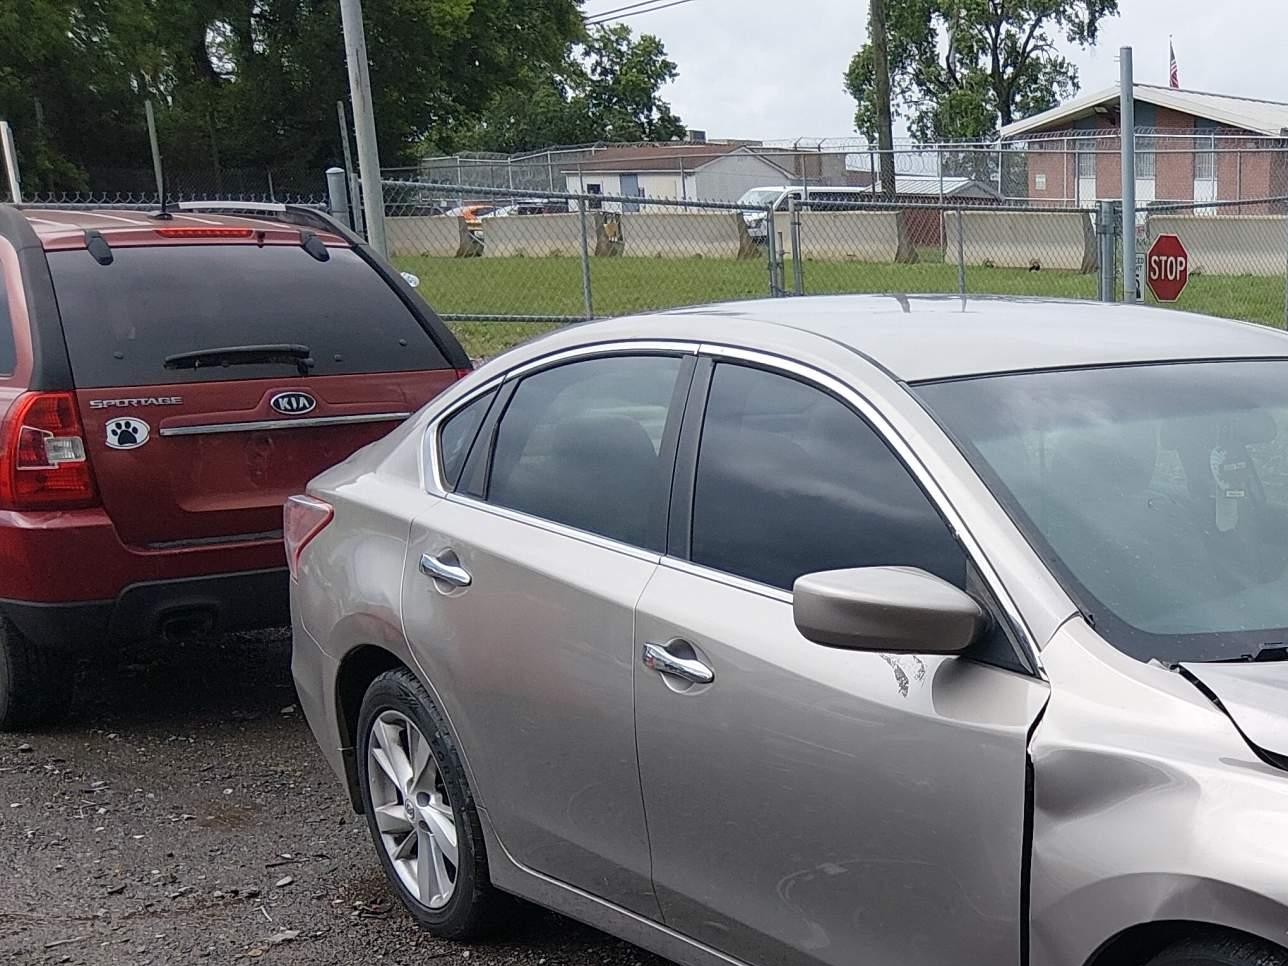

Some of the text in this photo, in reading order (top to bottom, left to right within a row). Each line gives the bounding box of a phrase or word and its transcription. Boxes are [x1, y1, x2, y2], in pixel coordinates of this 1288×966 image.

[1150, 255, 1186, 281] STOP
[89, 396, 184, 409] SPORTAGE
[278, 396, 310, 411] KIA
